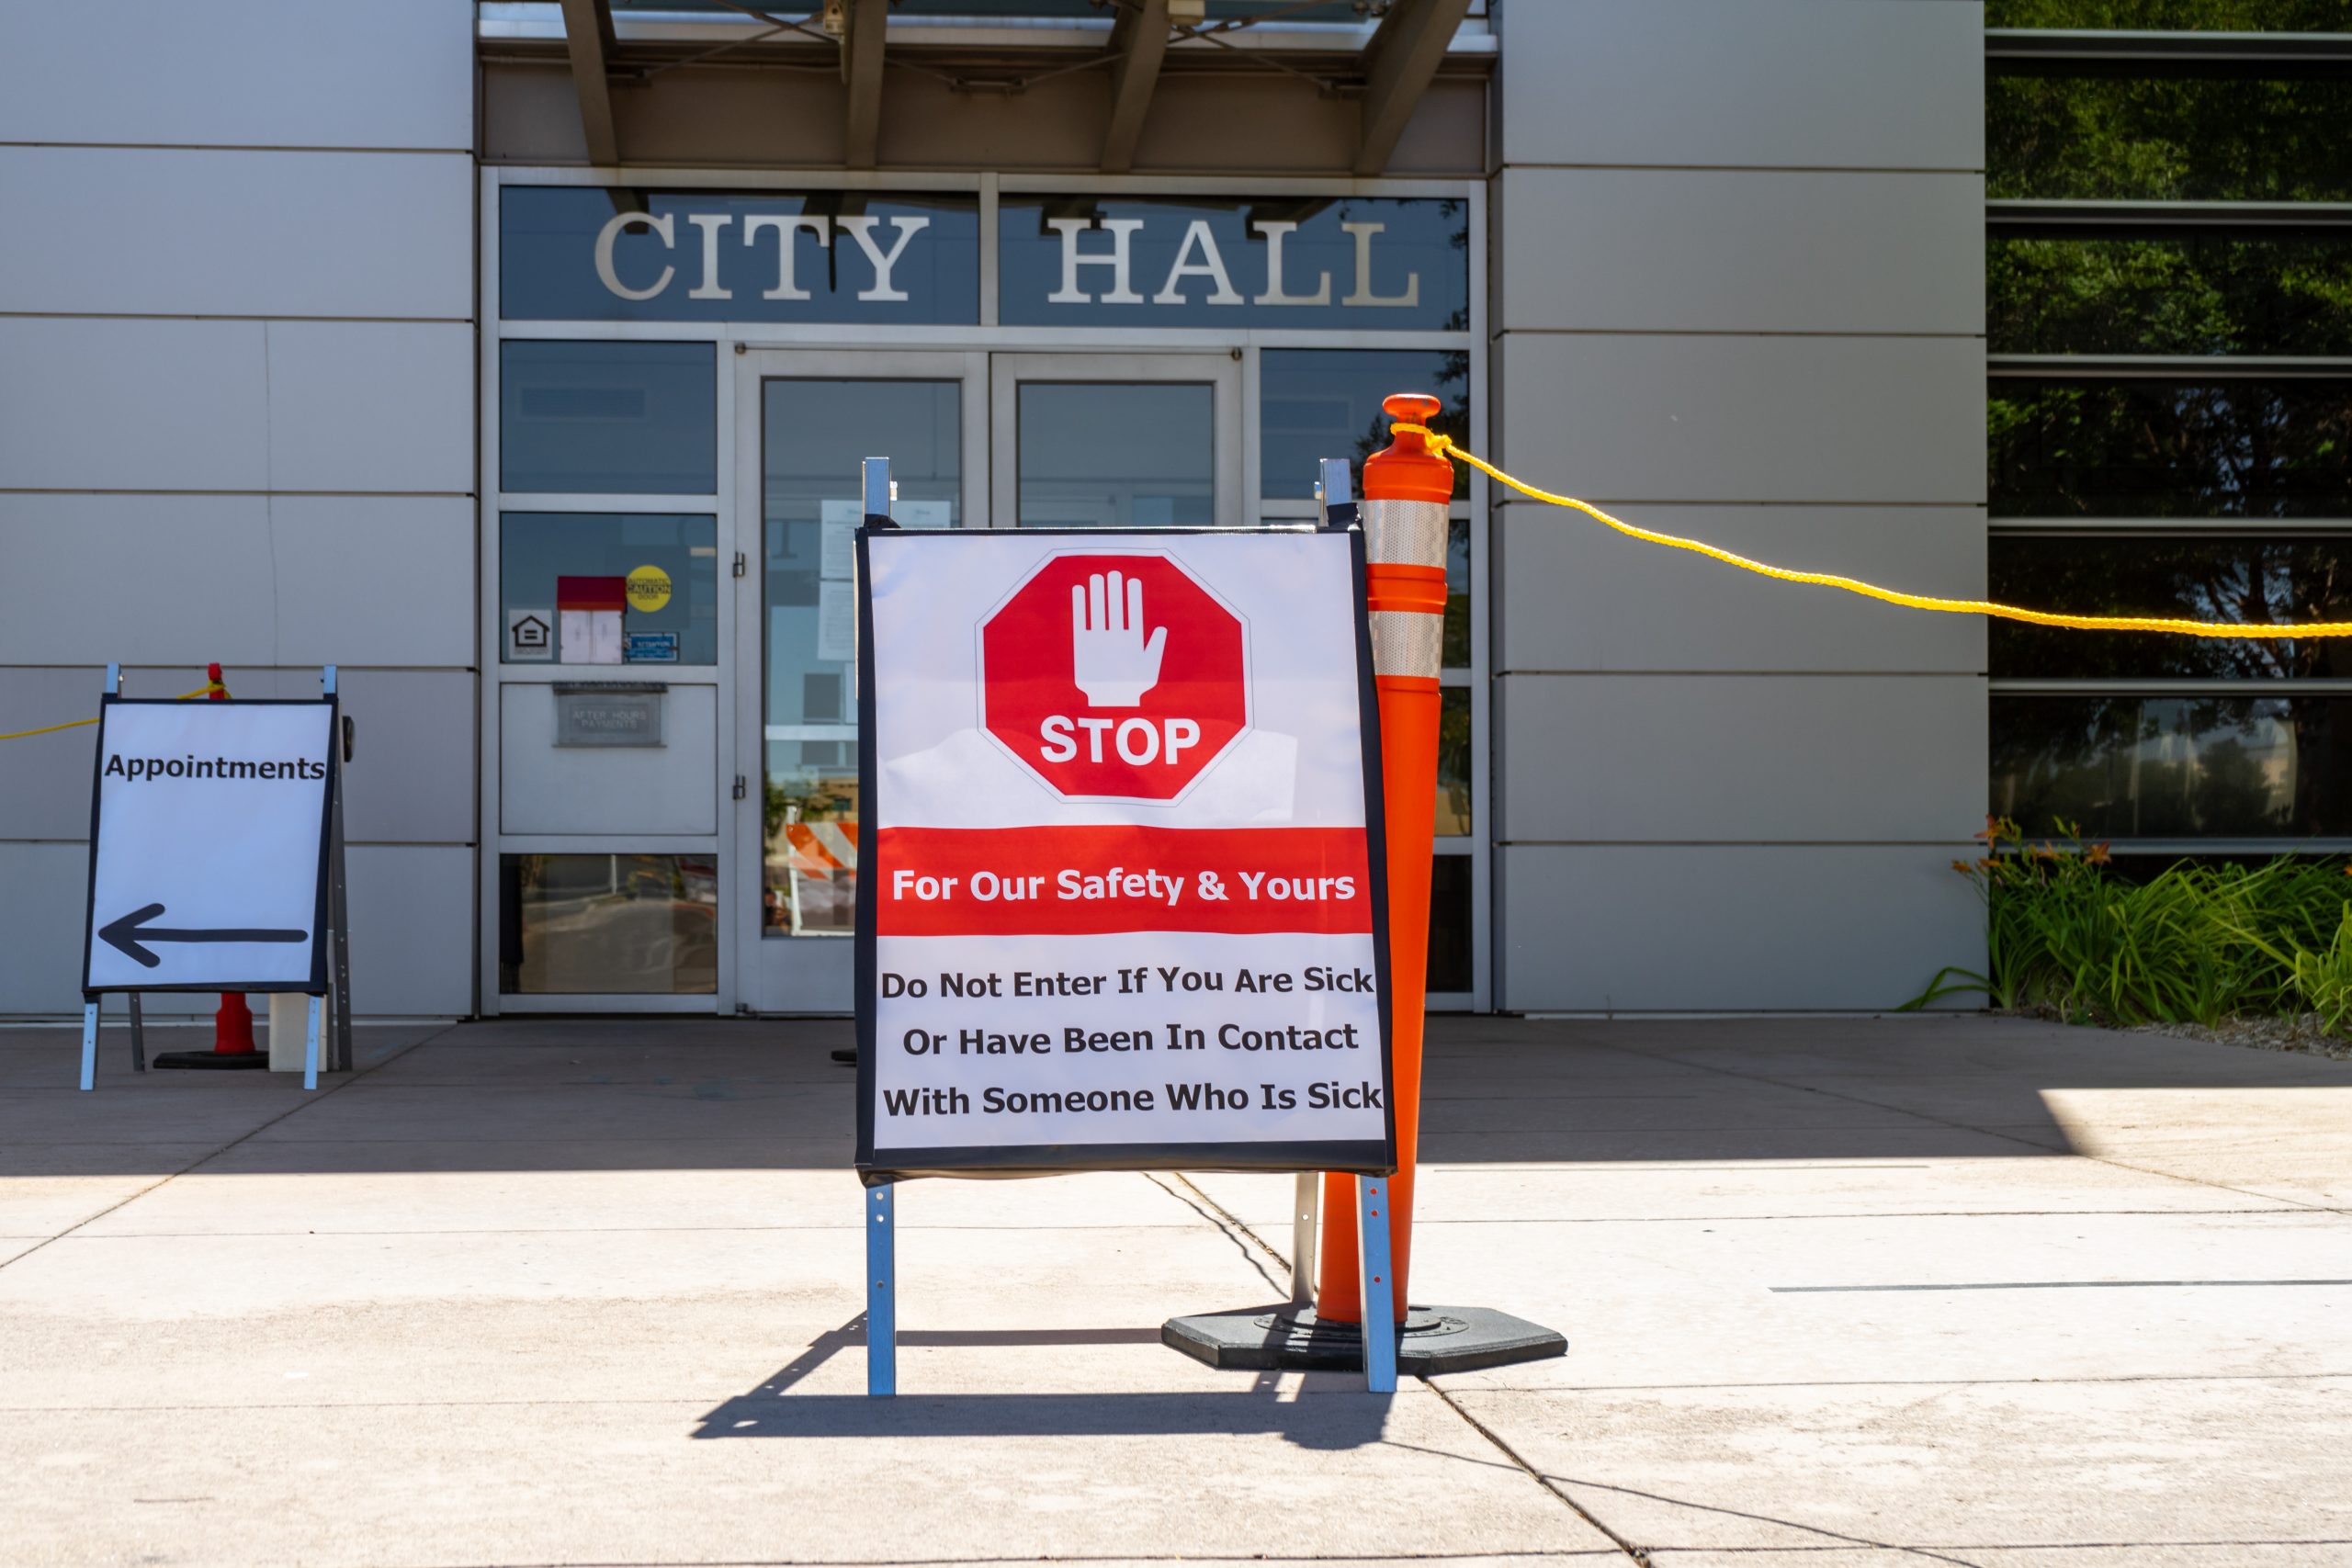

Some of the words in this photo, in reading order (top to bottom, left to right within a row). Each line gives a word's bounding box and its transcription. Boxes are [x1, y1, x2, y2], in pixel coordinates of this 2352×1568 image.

[596, 212, 929, 301] CITY
[1048, 219, 1419, 307] HALL
[1039, 715, 1201, 765] STOP
[104, 753, 325, 781] Appointments
[893, 870, 956, 900] For
[970, 871, 1045, 901] Our
[1057, 866, 1184, 907] Safety
[1197, 872, 1229, 901] &
[1238, 872, 1356, 901] Yours
[881, 972, 928, 998] Do
[940, 973, 1001, 998] Not
[1013, 971, 1107, 997] Enter
[1117, 966, 1148, 994] If
[1157, 966, 1224, 992] You
[1235, 969, 1293, 993] Are
[1303, 964, 1374, 992] Sick
[902, 1028, 947, 1055] Or
[959, 1028, 1051, 1055] Have
[1064, 1027, 1154, 1053] Been
[1166, 1023, 1205, 1051] In
[1217, 1022, 1359, 1052] Contact
[883, 1087, 970, 1117] With
[982, 1086, 1155, 1114] Someone
[1165, 1081, 1250, 1111] Who
[1260, 1083, 1297, 1111] Is
[1308, 1081, 1384, 1110] Sick
